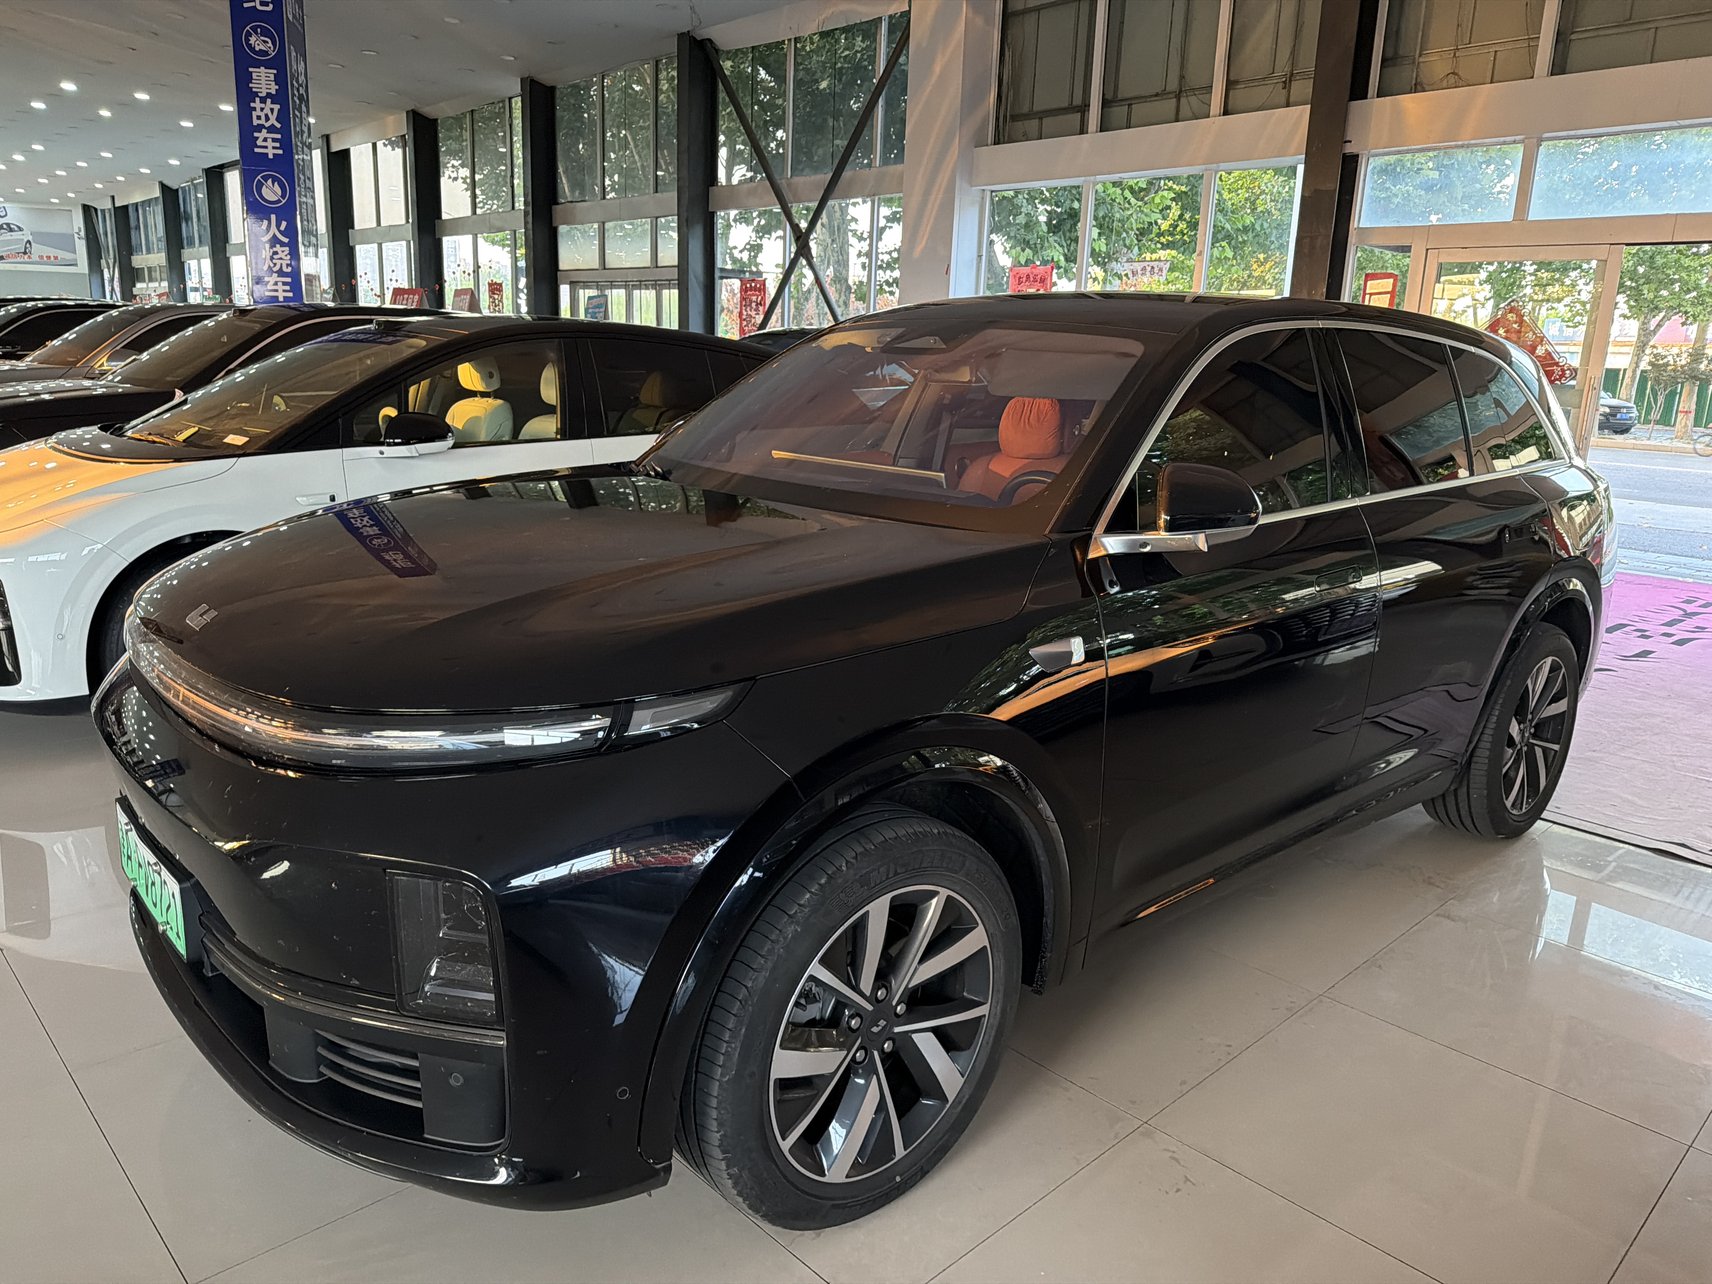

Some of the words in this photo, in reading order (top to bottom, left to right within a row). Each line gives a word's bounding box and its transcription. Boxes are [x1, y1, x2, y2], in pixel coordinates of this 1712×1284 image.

[248, 66, 283, 159] 事故车
[260, 214, 293, 302] 火烧车
